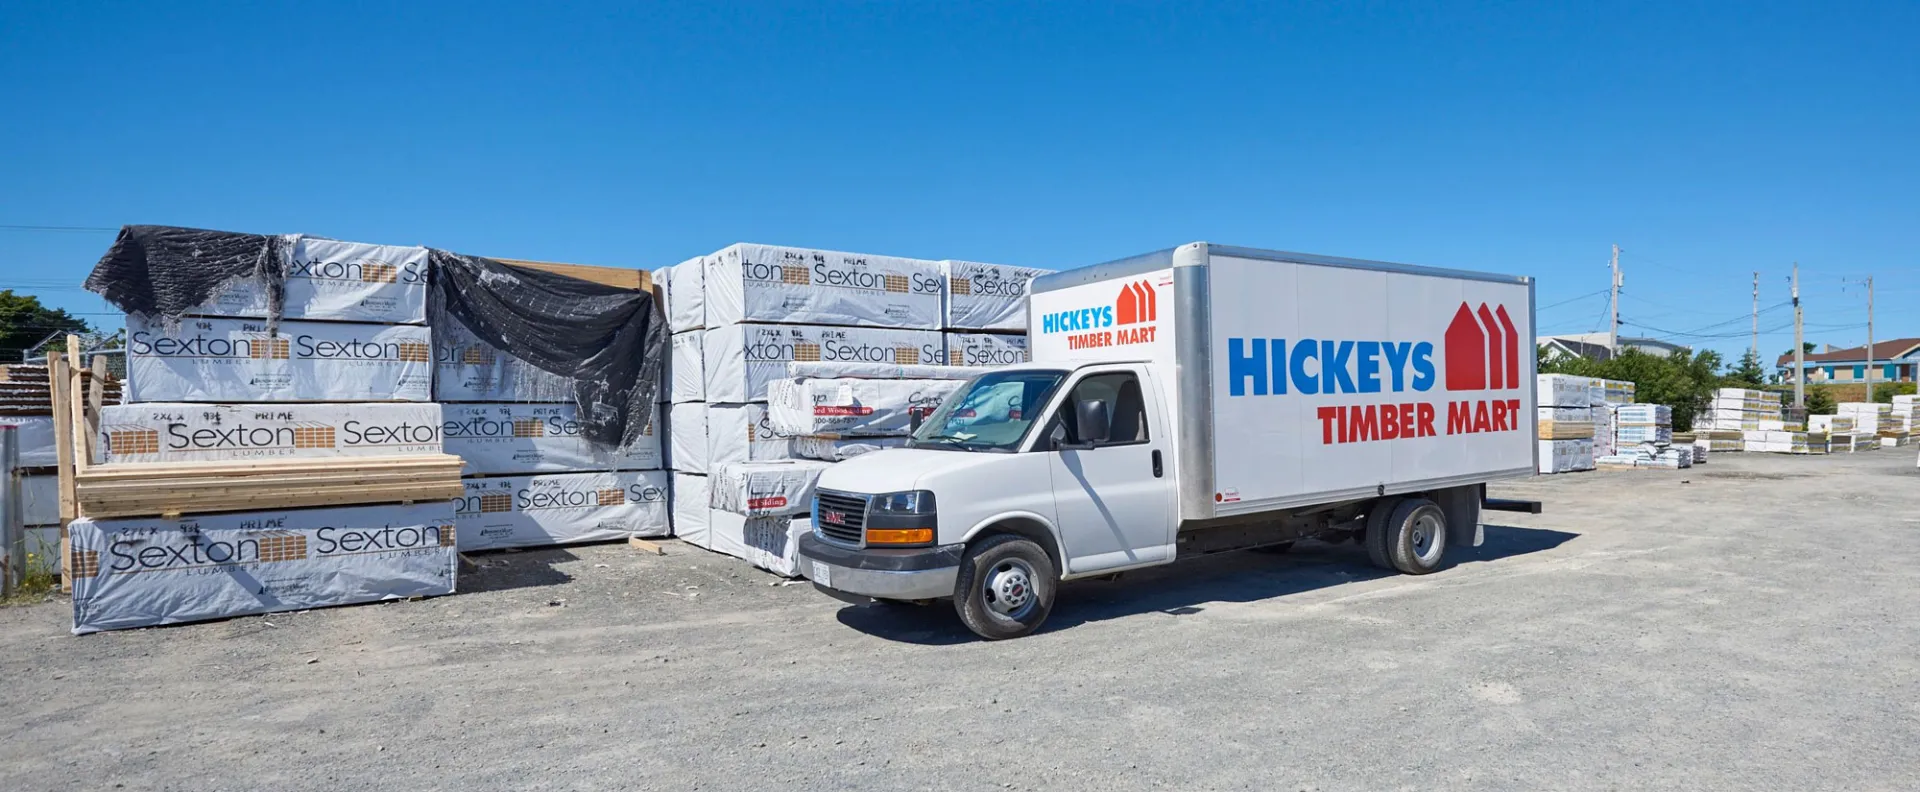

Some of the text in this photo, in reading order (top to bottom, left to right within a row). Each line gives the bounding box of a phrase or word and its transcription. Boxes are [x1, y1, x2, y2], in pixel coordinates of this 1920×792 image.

[743, 259, 783, 280] ton
[815, 264, 886, 288] Sexton
[1043, 305, 1113, 334] HICKEYS
[132, 331, 400, 359] Sexton Sexton
[825, 340, 896, 361] Sexton
[1068, 326, 1156, 350] TIMBER MART
[966, 345, 1024, 364] Sexton
[1228, 337, 1435, 396] HICKEYS
[255, 411, 294, 421] PRIME
[533, 408, 560, 416] PRIME
[1317, 399, 1520, 445] TIMBER MART
[168, 423, 295, 448] Sexton
[443, 418, 514, 436] exton
[517, 488, 598, 510] Sexton
[630, 484, 667, 502] Sex
[240, 517, 285, 529] PRIME
[110, 524, 440, 570] Sexton Sexton
[186, 549, 440, 576] LUMBER LUMBER
